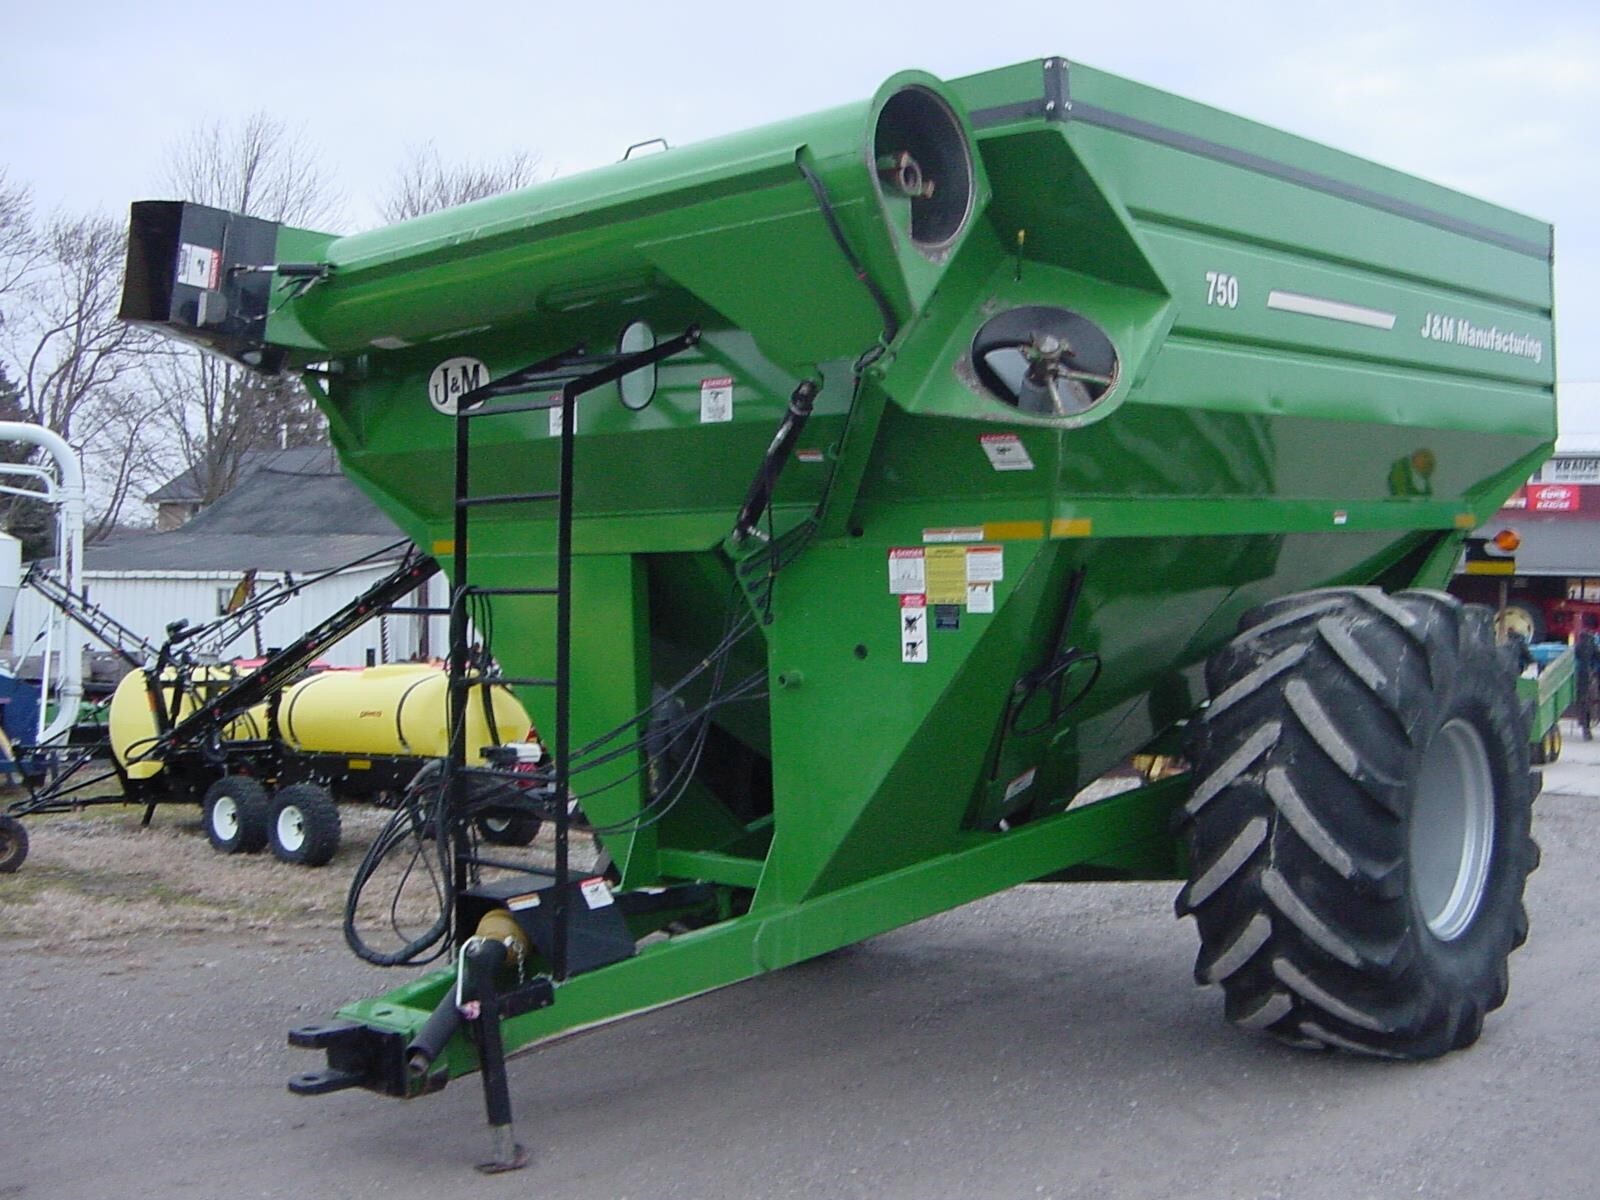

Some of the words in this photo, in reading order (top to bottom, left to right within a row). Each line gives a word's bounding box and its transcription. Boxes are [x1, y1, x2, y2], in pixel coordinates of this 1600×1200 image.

[1206, 271, 1239, 308] 750
[1421, 312, 1455, 342] J&M
[1456, 319, 1542, 364] Manufacturing
[433, 364, 480, 405] J&M
